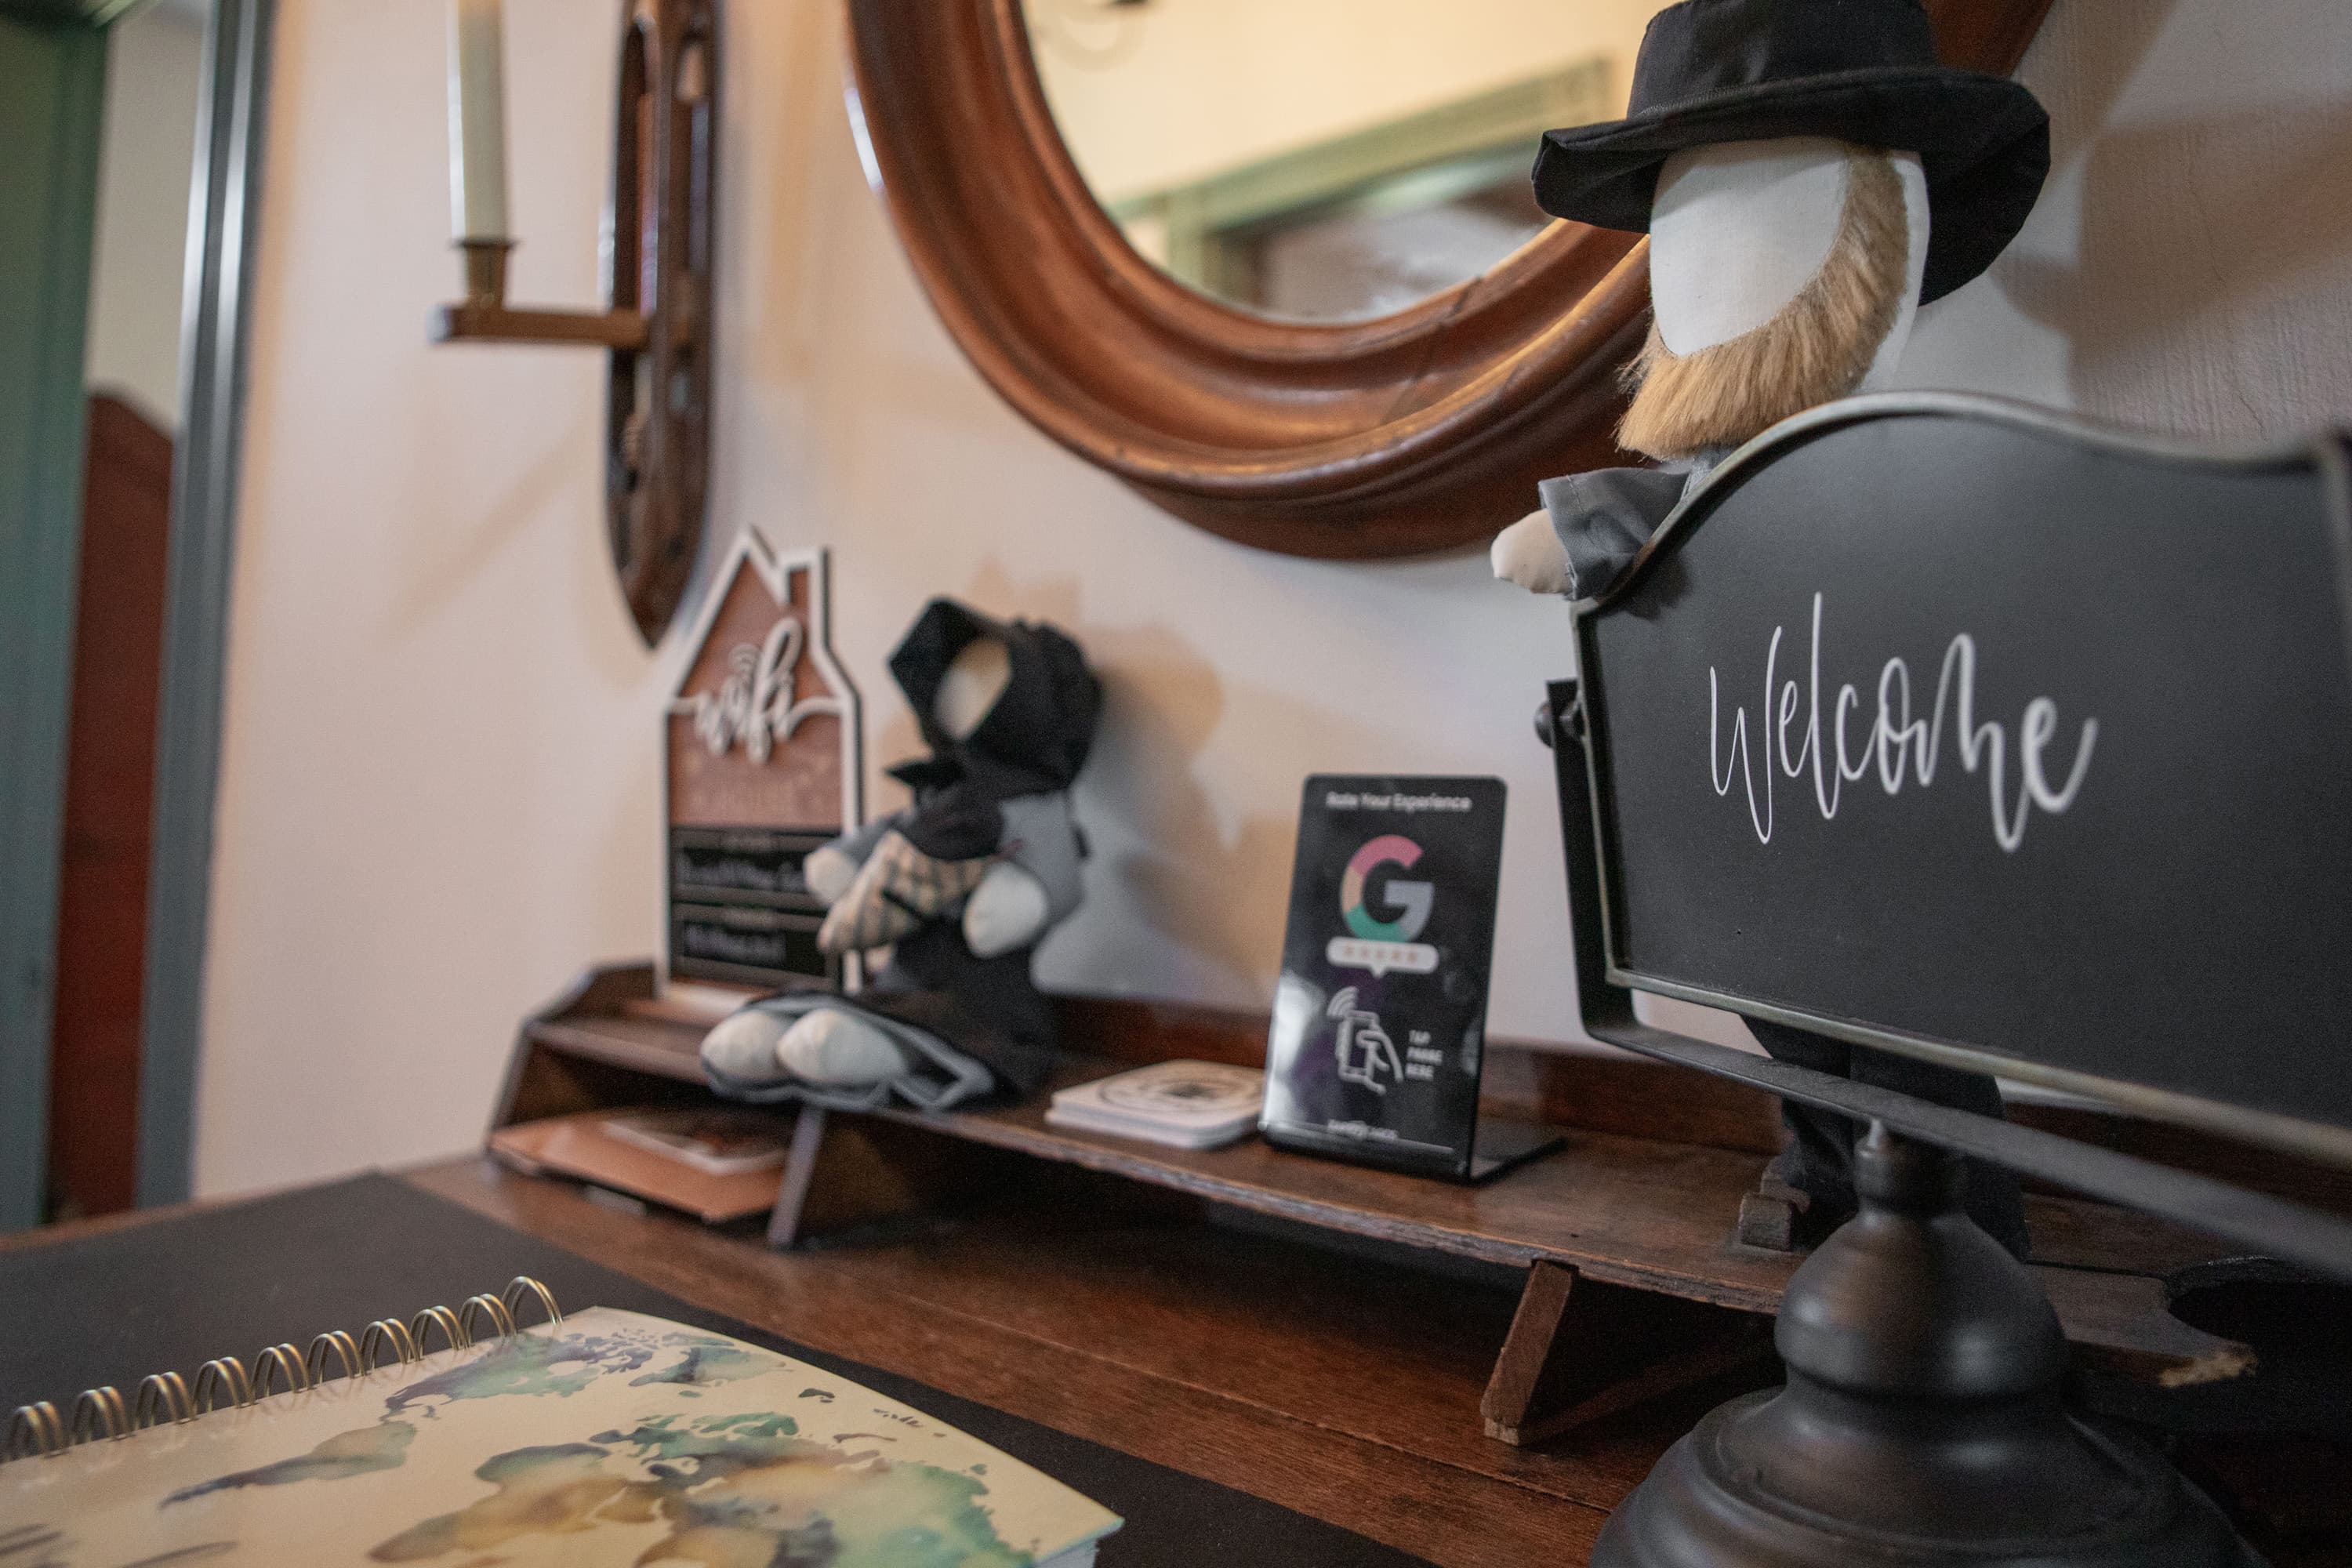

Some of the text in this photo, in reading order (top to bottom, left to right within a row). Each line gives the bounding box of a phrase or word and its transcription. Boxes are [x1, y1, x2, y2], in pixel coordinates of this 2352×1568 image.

[1361, 792, 1392, 810] Your
[1393, 793, 1472, 813] Experience
[1341, 834, 1435, 942] G
